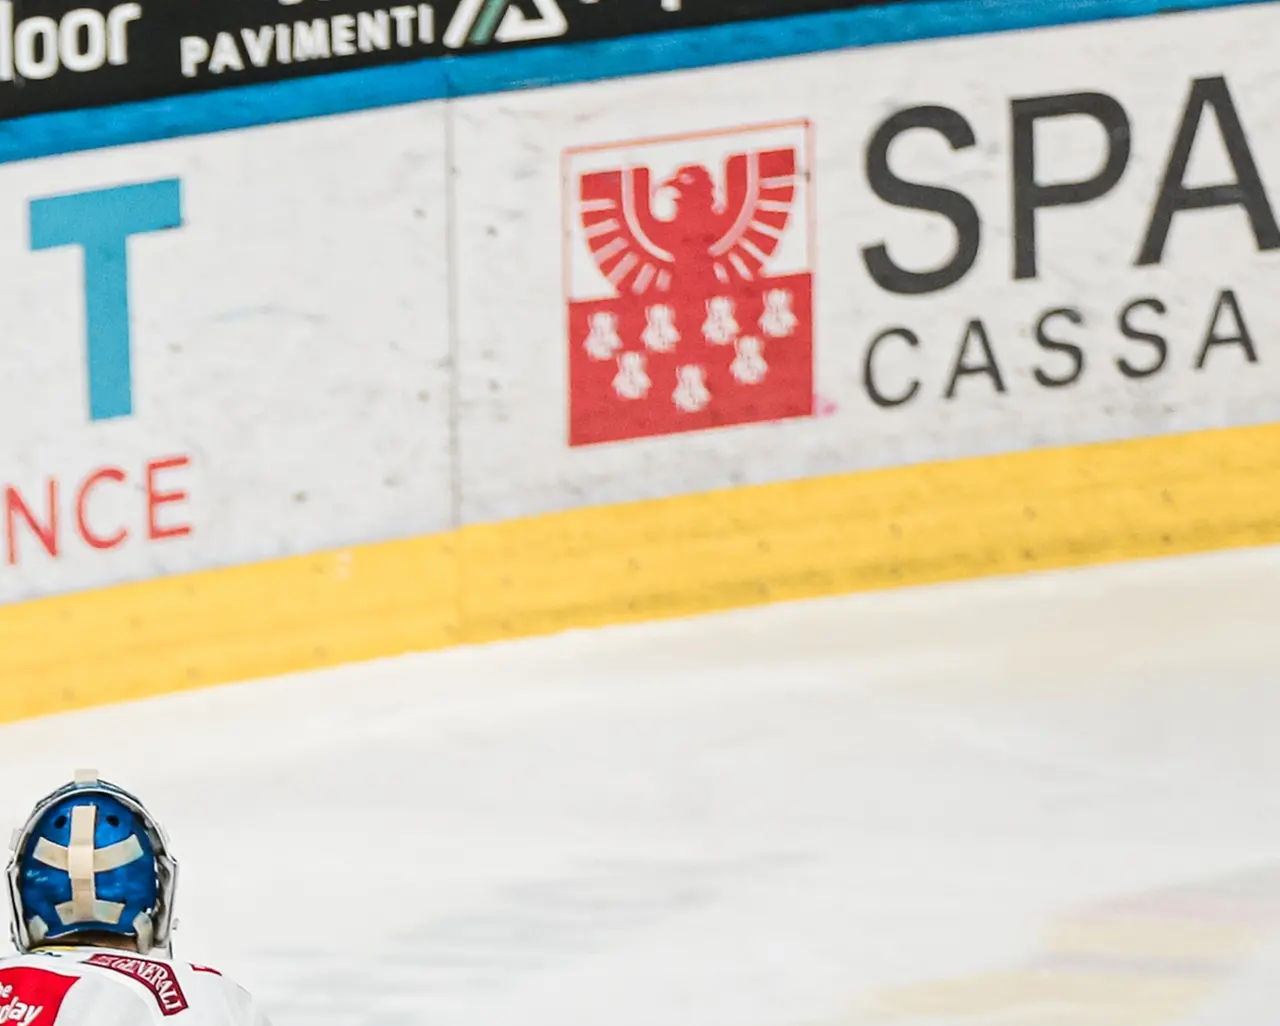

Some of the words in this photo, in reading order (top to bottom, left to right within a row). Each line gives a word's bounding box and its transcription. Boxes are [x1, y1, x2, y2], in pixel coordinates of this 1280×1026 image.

[180, 4, 435, 77] PAVIMENTI
[861, 290, 1260, 409] CASSA
[113, 958, 182, 1011] GENERALI
